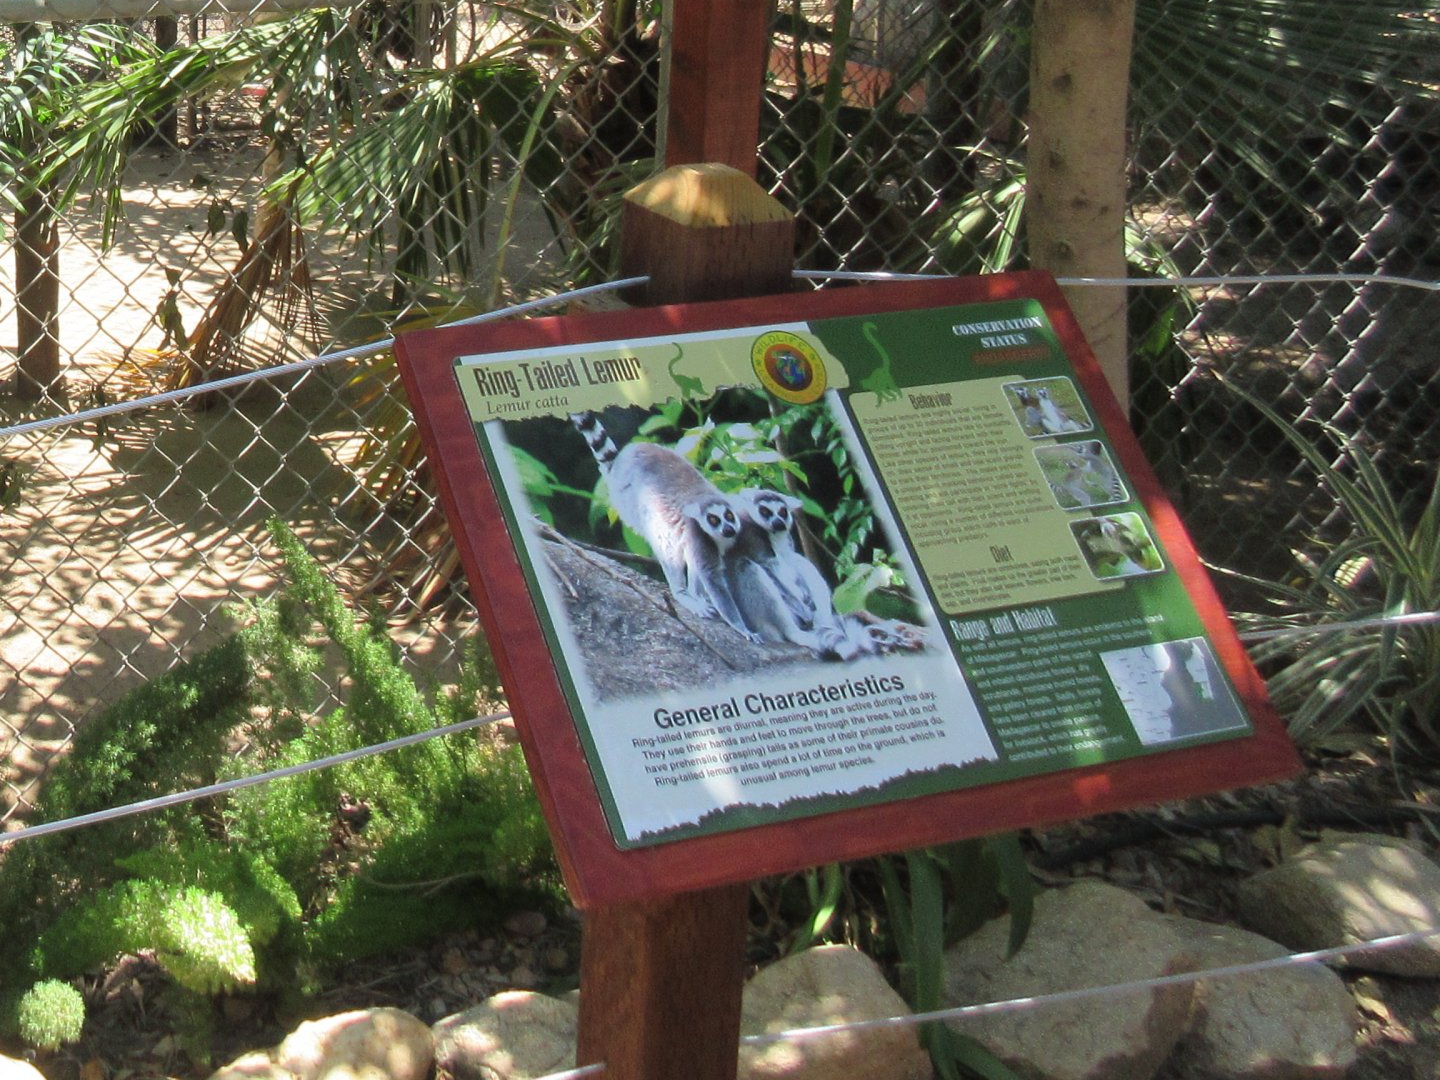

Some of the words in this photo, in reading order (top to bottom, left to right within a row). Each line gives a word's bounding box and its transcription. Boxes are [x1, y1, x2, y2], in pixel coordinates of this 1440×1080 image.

[951, 316, 1043, 336] CONSERVATION
[980, 333, 1028, 348] STATUS
[472, 358, 581, 399] Ring-Tailed
[580, 355, 642, 386] Lemur
[486, 399, 532, 415] Lemur
[535, 395, 570, 409] catta
[908, 391, 953, 410] Behavior
[989, 544, 1015, 563] Diet
[948, 619, 991, 642] Range
[989, 612, 1015, 636] and
[1010, 606, 1059, 632] Habitat
[632, 732, 682, 748] Ring-tailed
[683, 728, 716, 739] lemurs
[717, 725, 732, 734] are
[769, 712, 809, 724] meaning
[808, 709, 829, 719] they
[830, 706, 845, 715] are
[846, 701, 873, 713] active
[873, 697, 903, 708] during
[902, 694, 918, 703] the
[918, 692, 937, 701] day.
[654, 698, 740, 729] General
[745, 676, 904, 714] Characteristics
[642, 750, 666, 760] They
[667, 747, 685, 756] use
[686, 742, 707, 753] their
[709, 737, 738, 749] hands
[739, 733, 757, 744] and
[788, 725, 813, 736] move
[814, 718, 850, 731] through
[850, 716, 866, 725] the
[892, 708, 908, 718] but
[922, 703, 937, 713] not
[644, 763, 668, 774] have
[669, 755, 718, 772] prehensile
[719, 746, 766, 763] (grasping)
[801, 736, 826, 748] some
[837, 729, 858, 741] their
[859, 725, 894, 739] primate
[894, 719, 929, 732] cousins
[654, 770, 705, 786] Ring-tailed
[706, 765, 739, 778] lemurs
[740, 761, 760, 772] also
[761, 755, 790, 769] spend
[797, 751, 811, 762] lot
[822, 748, 843, 758] time
[857, 742, 873, 751] the
[909, 731, 936, 742] which
[740, 771, 777, 786] unusual
[778, 767, 811, 780] among
[810, 762, 836, 773] lemur
[838, 756, 874, 770] species.
